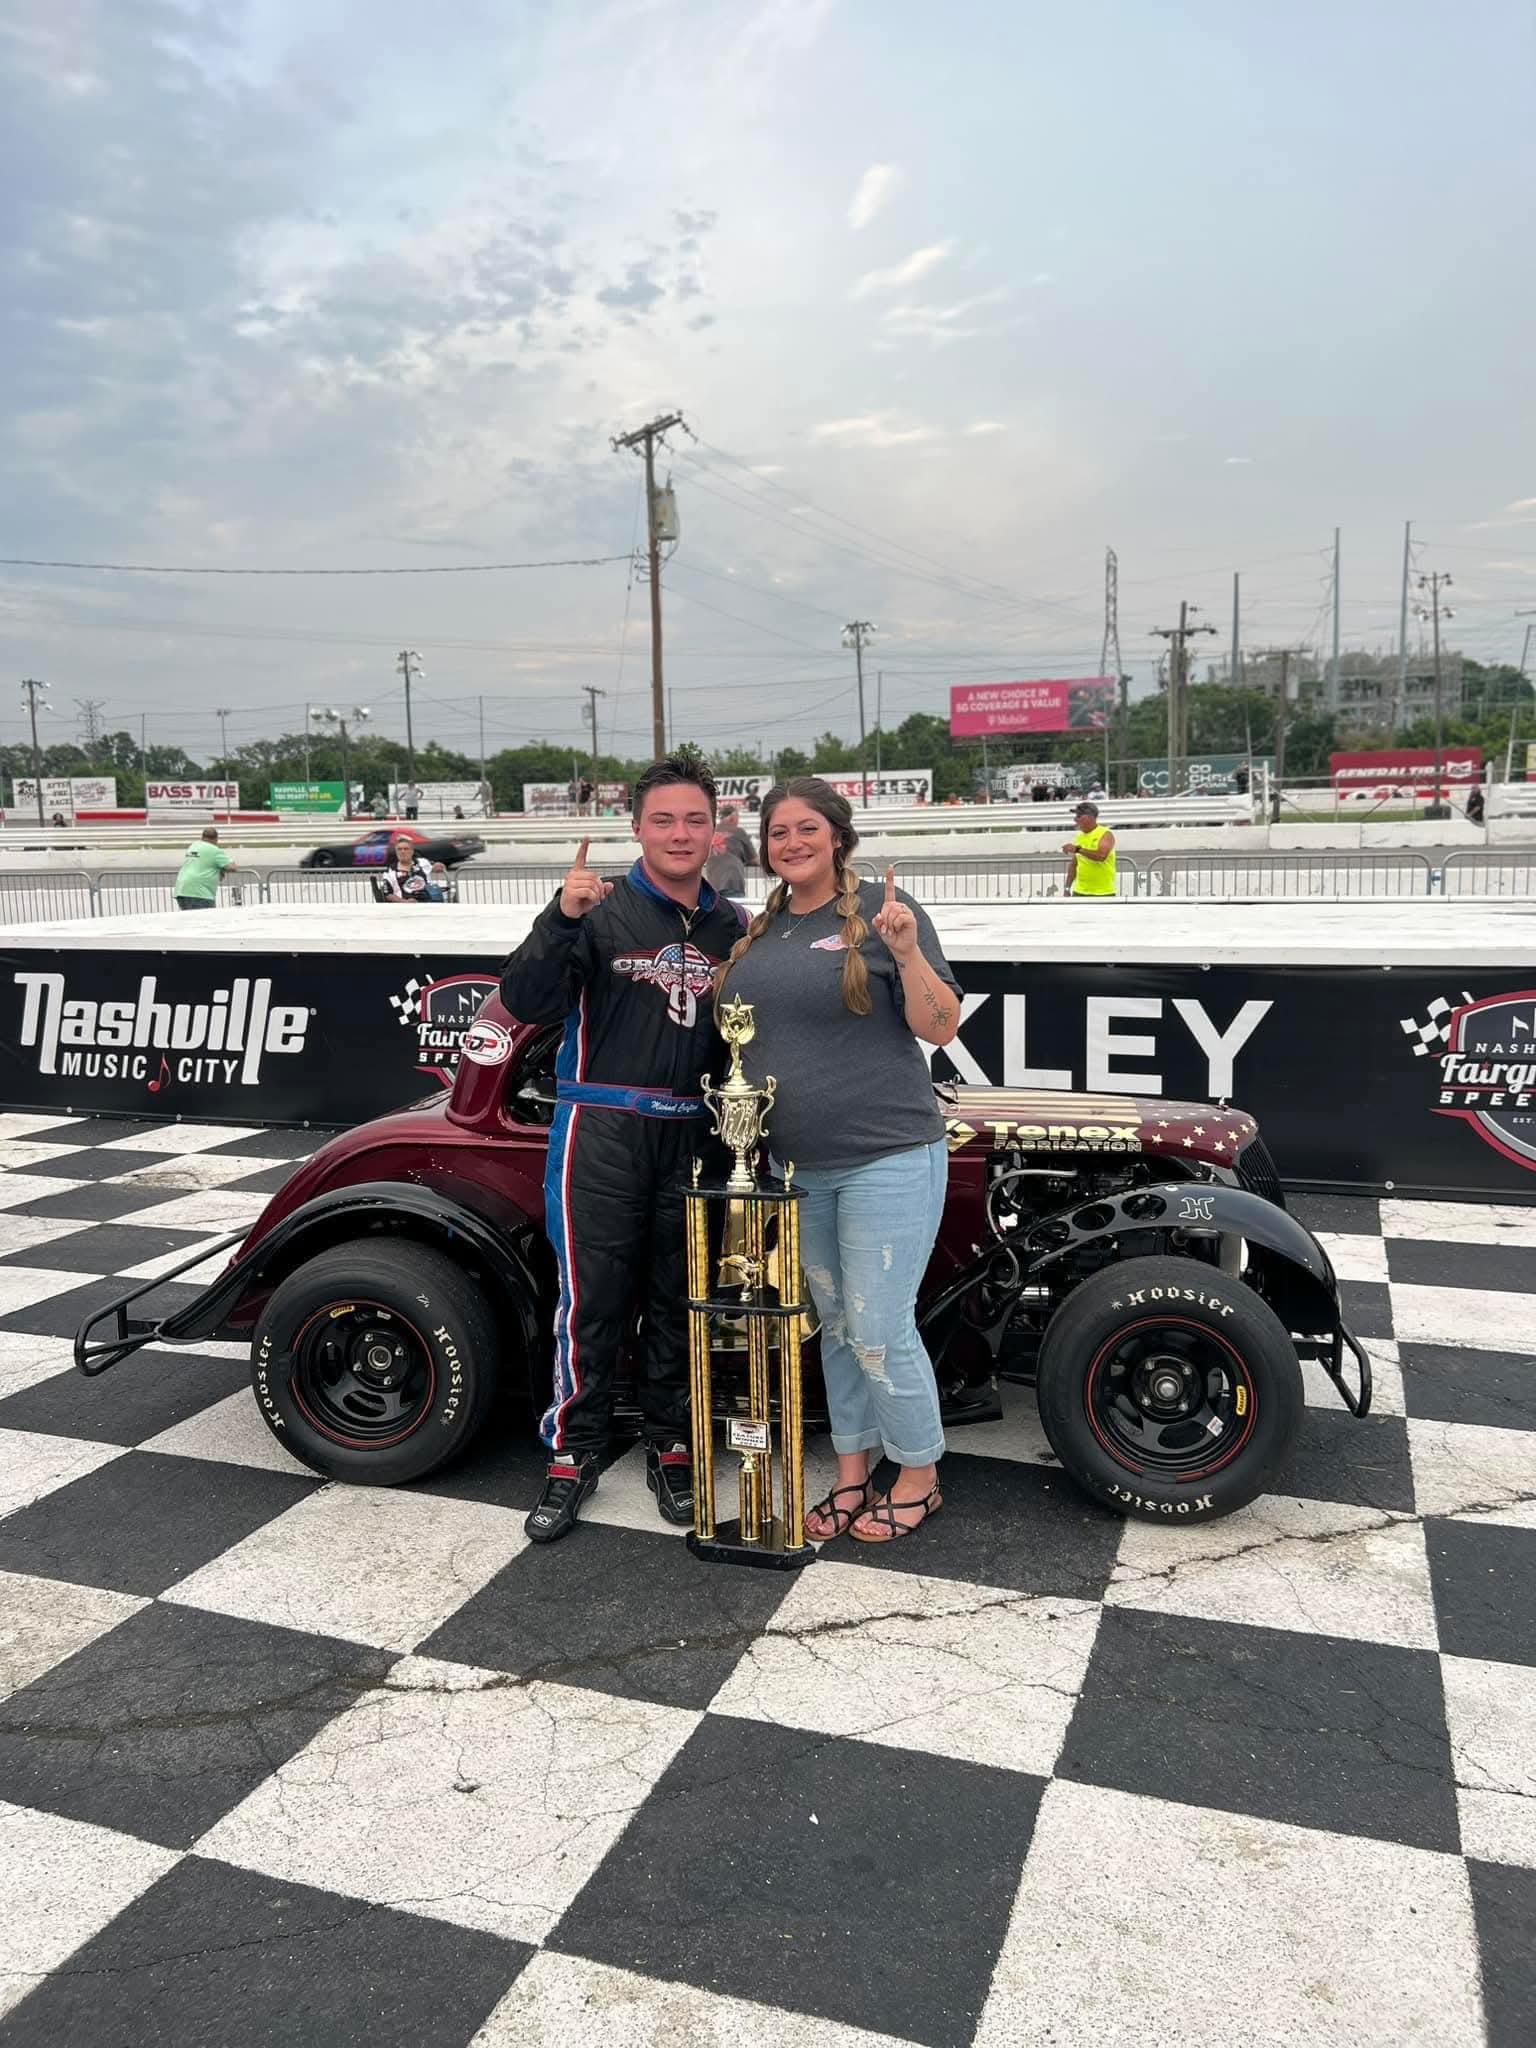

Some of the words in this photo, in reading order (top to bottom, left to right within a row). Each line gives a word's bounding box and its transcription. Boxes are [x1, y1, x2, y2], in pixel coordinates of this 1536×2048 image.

[967, 692, 974, 702] A
[976, 690, 999, 701] NEW
[1001, 688, 1036, 700] CHOICE
[1038, 687, 1050, 698] IN
[970, 700, 1021, 713] COVERAGE
[1030, 697, 1062, 709] VALUE
[148, 785, 193, 799] BASS
[14, 972, 310, 1084] Nashville
[61, 1052, 147, 1080] MUSIC
[177, 1056, 238, 1083] CITY
[993, 1139, 1143, 1153] FABRICATION
[1127, 1286, 1235, 1318] Hoosier
[257, 1335, 287, 1429] Hoosier
[432, 1325, 464, 1420] Hoosier
[1107, 1484, 1214, 1514] Hoosier
